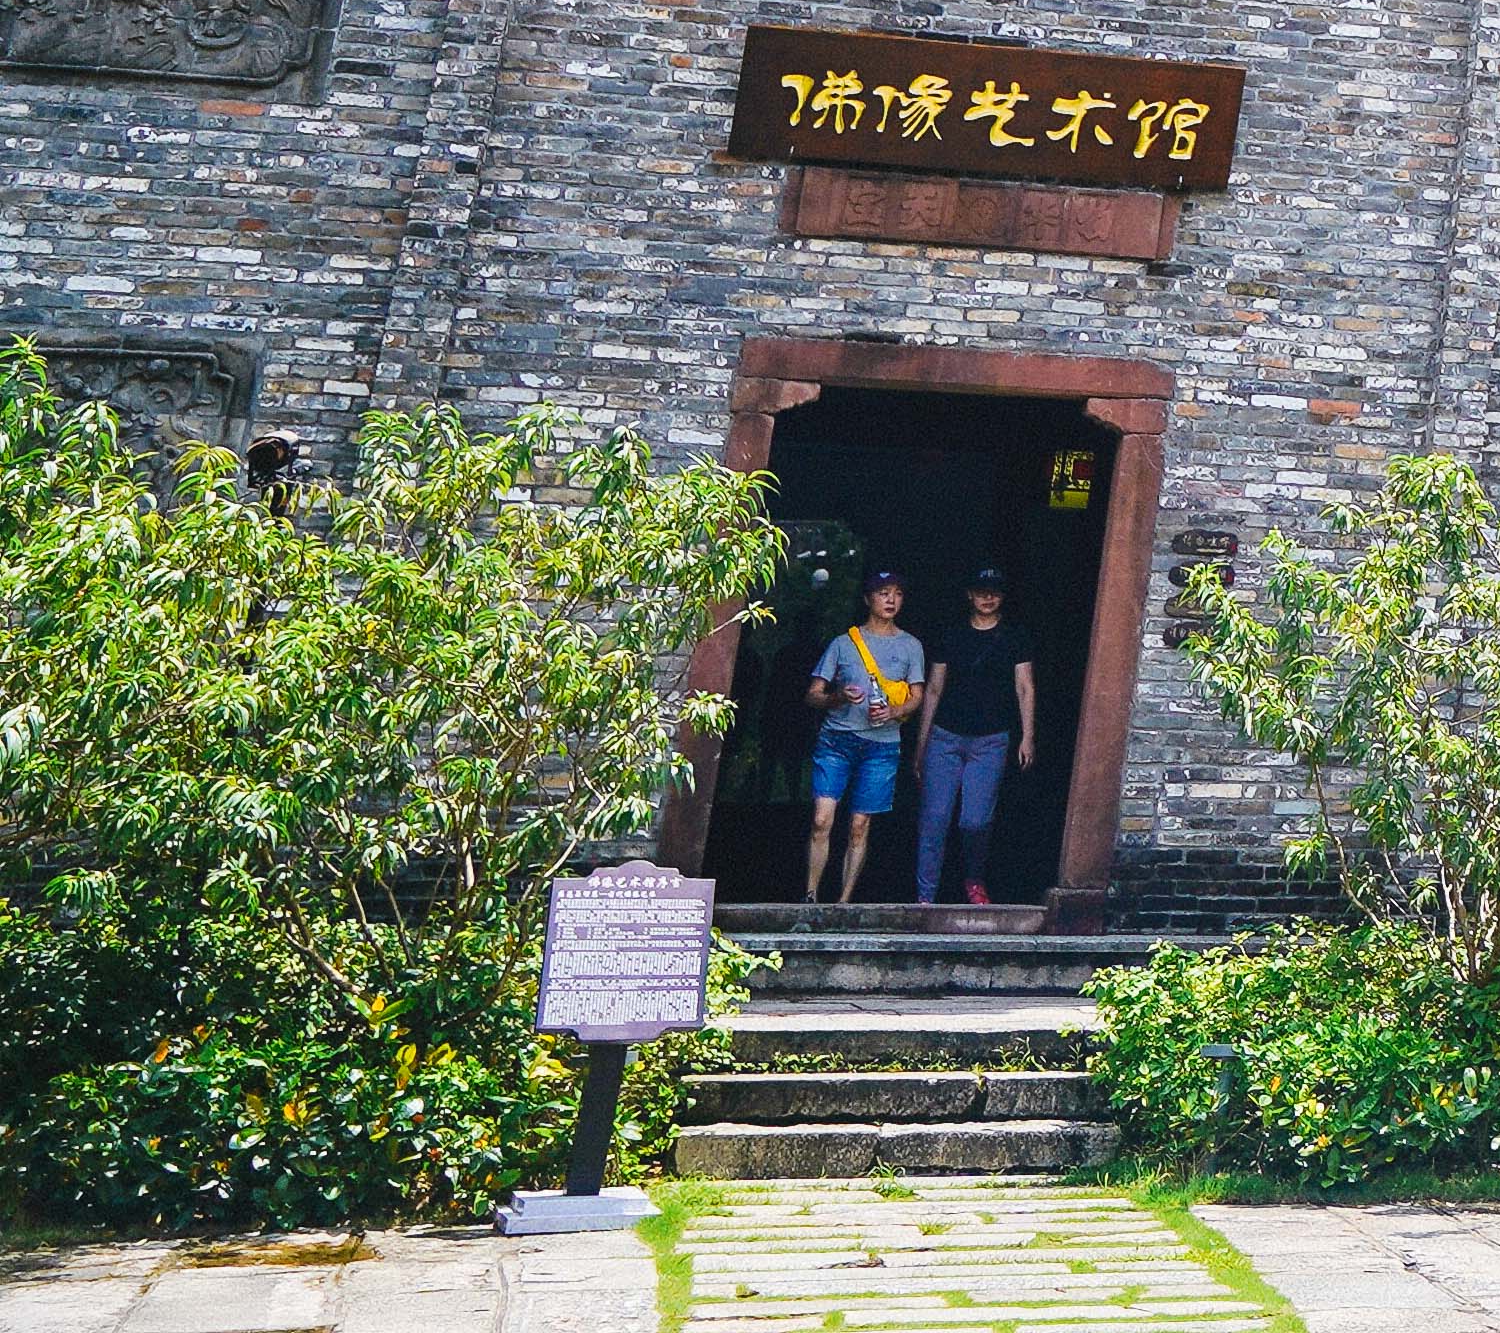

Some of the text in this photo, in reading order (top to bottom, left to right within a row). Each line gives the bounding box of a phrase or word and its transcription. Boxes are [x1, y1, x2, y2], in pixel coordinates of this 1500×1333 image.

[781, 69, 1211, 161] 佛像艺术馆
